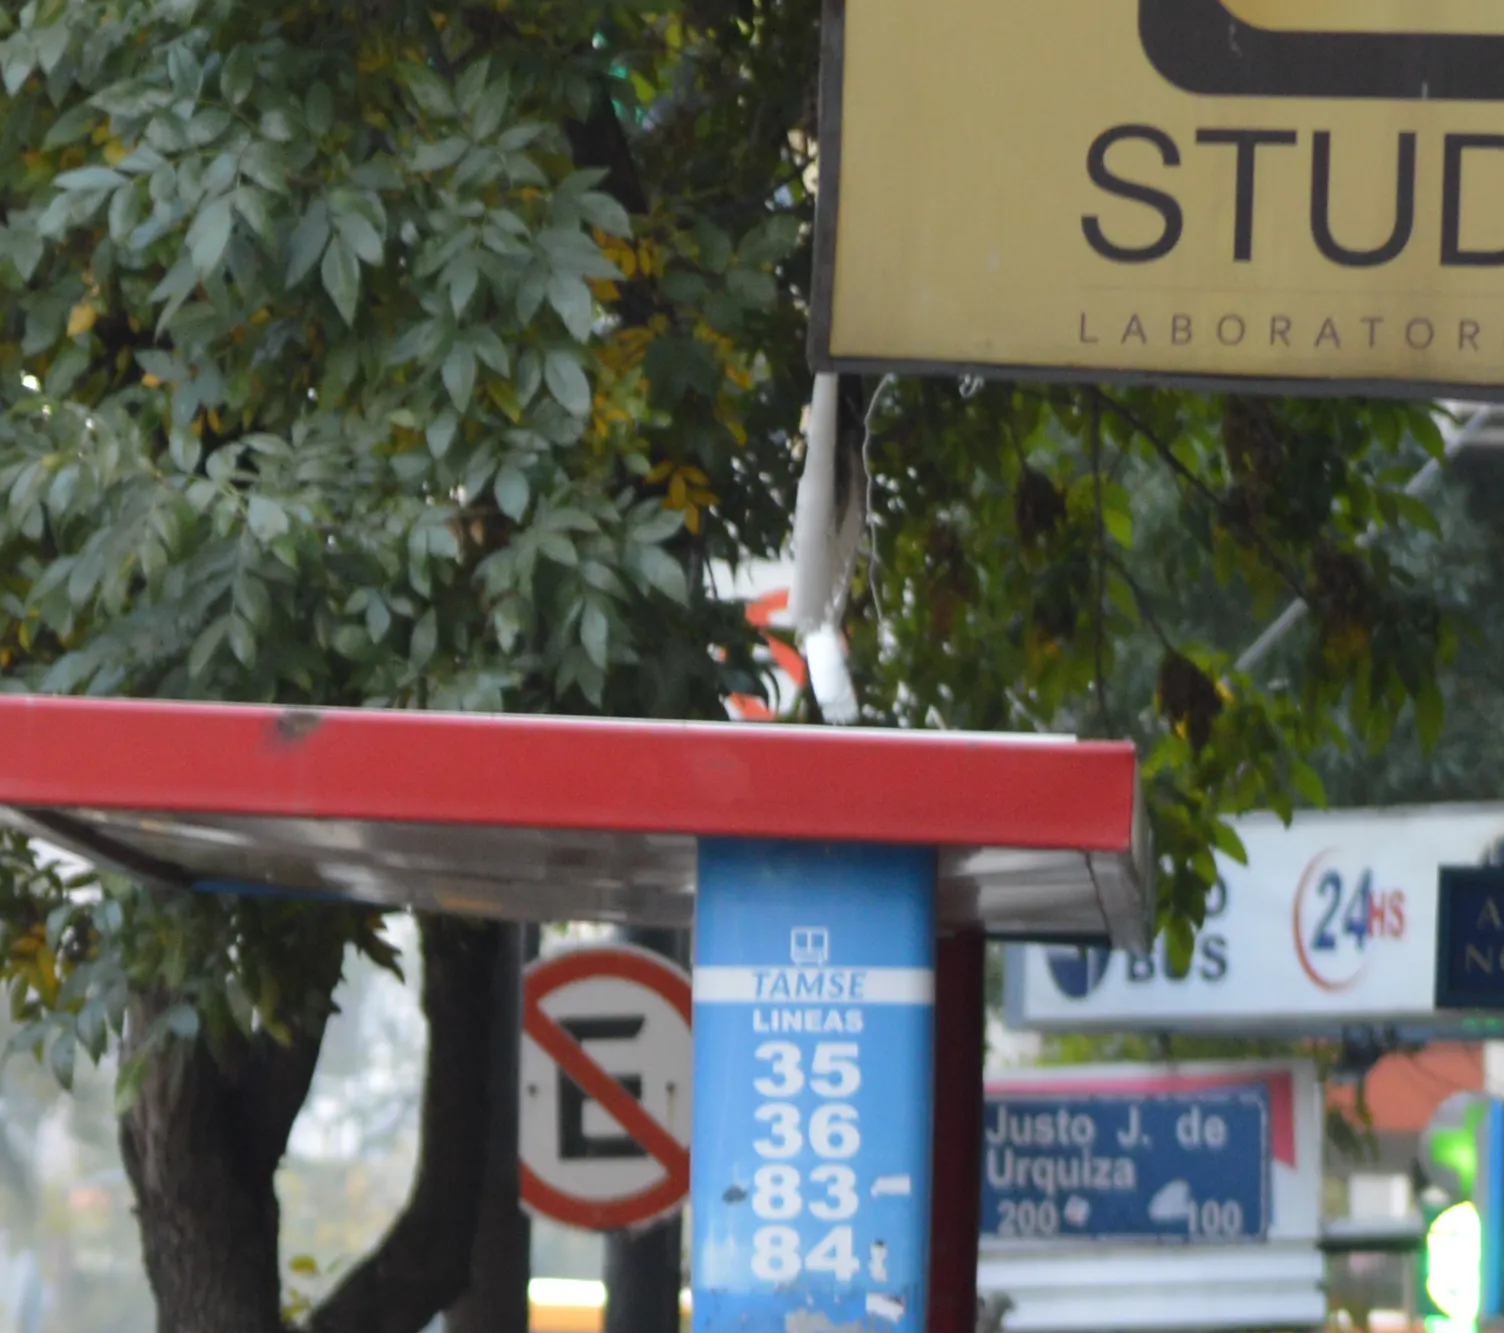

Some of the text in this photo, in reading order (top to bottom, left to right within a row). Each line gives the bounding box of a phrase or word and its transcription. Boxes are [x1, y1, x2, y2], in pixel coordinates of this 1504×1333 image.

[751, 970, 868, 1000] TAMSE
[752, 1009, 864, 1033] LINEAS
[752, 1040, 863, 1098] 35
[752, 1103, 862, 1160] 36
[984, 1104, 1096, 1147] Justo
[1175, 1105, 1228, 1149] de
[750, 1163, 860, 1220] 83
[985, 1147, 1137, 1194] Urquiza
[997, 1199, 1058, 1237] 200
[750, 1225, 861, 1282] 84
